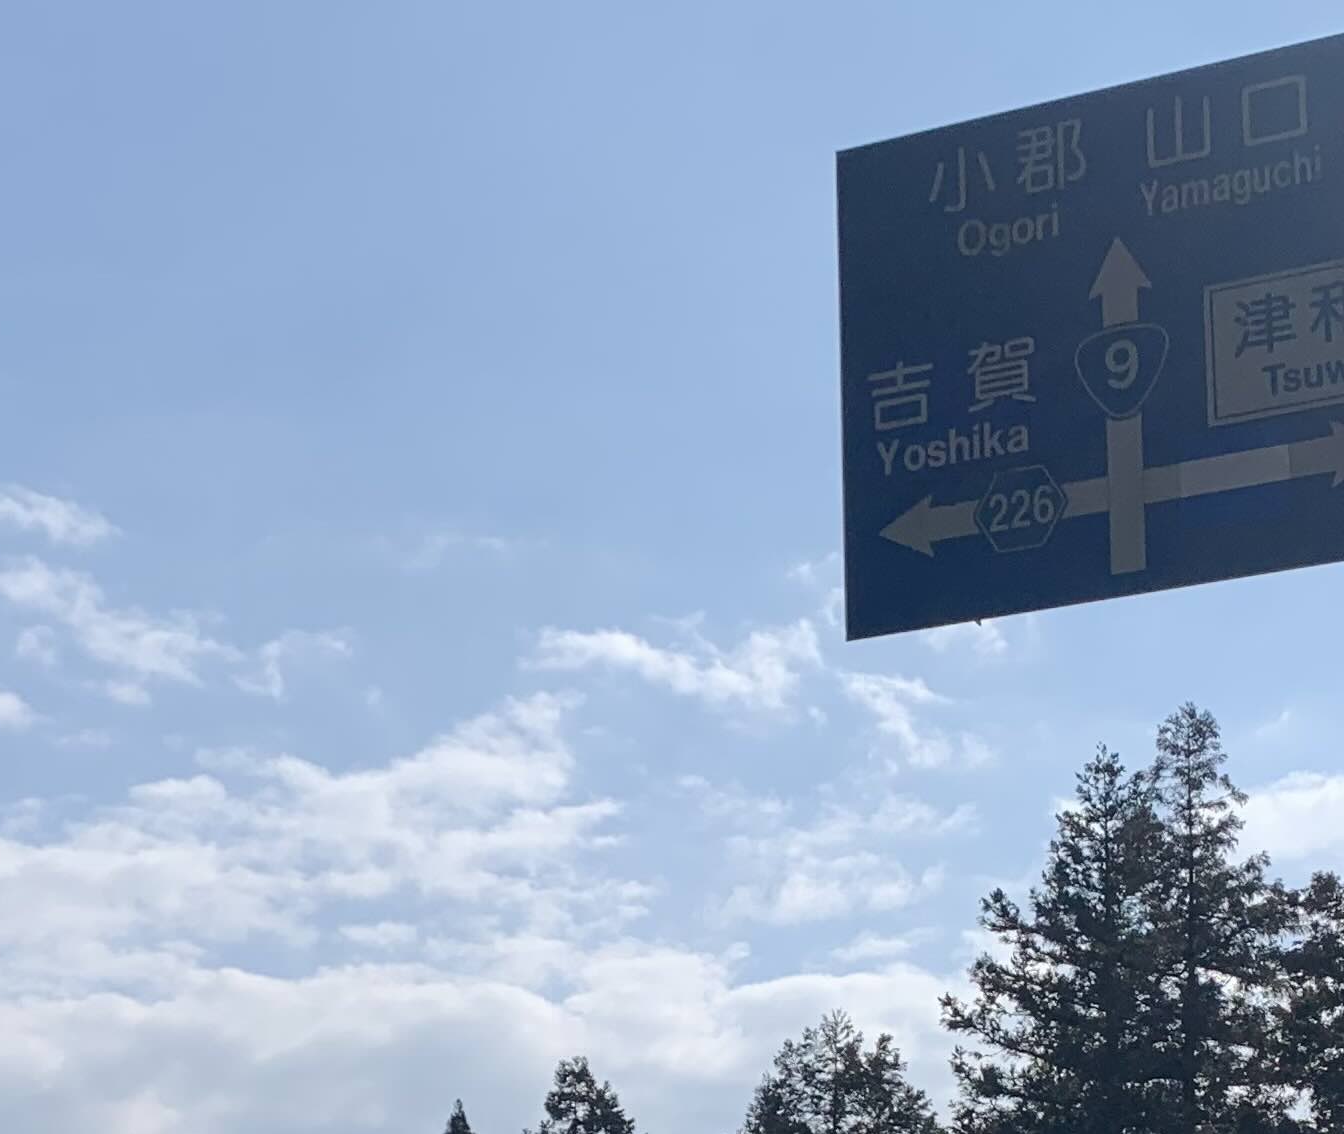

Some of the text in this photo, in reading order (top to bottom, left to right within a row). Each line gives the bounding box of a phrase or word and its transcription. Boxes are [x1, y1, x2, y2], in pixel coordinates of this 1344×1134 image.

[1146, 75, 1309, 169] 山口
[928, 117, 1087, 213] 小郡
[1138, 145, 1323, 217] Yamaguchi
[956, 204, 1060, 257] Ogori
[866, 336, 1037, 432] 吉賀
[1103, 340, 1140, 390] 9
[875, 422, 1031, 476] Yoshika
[988, 484, 1056, 533] 226
